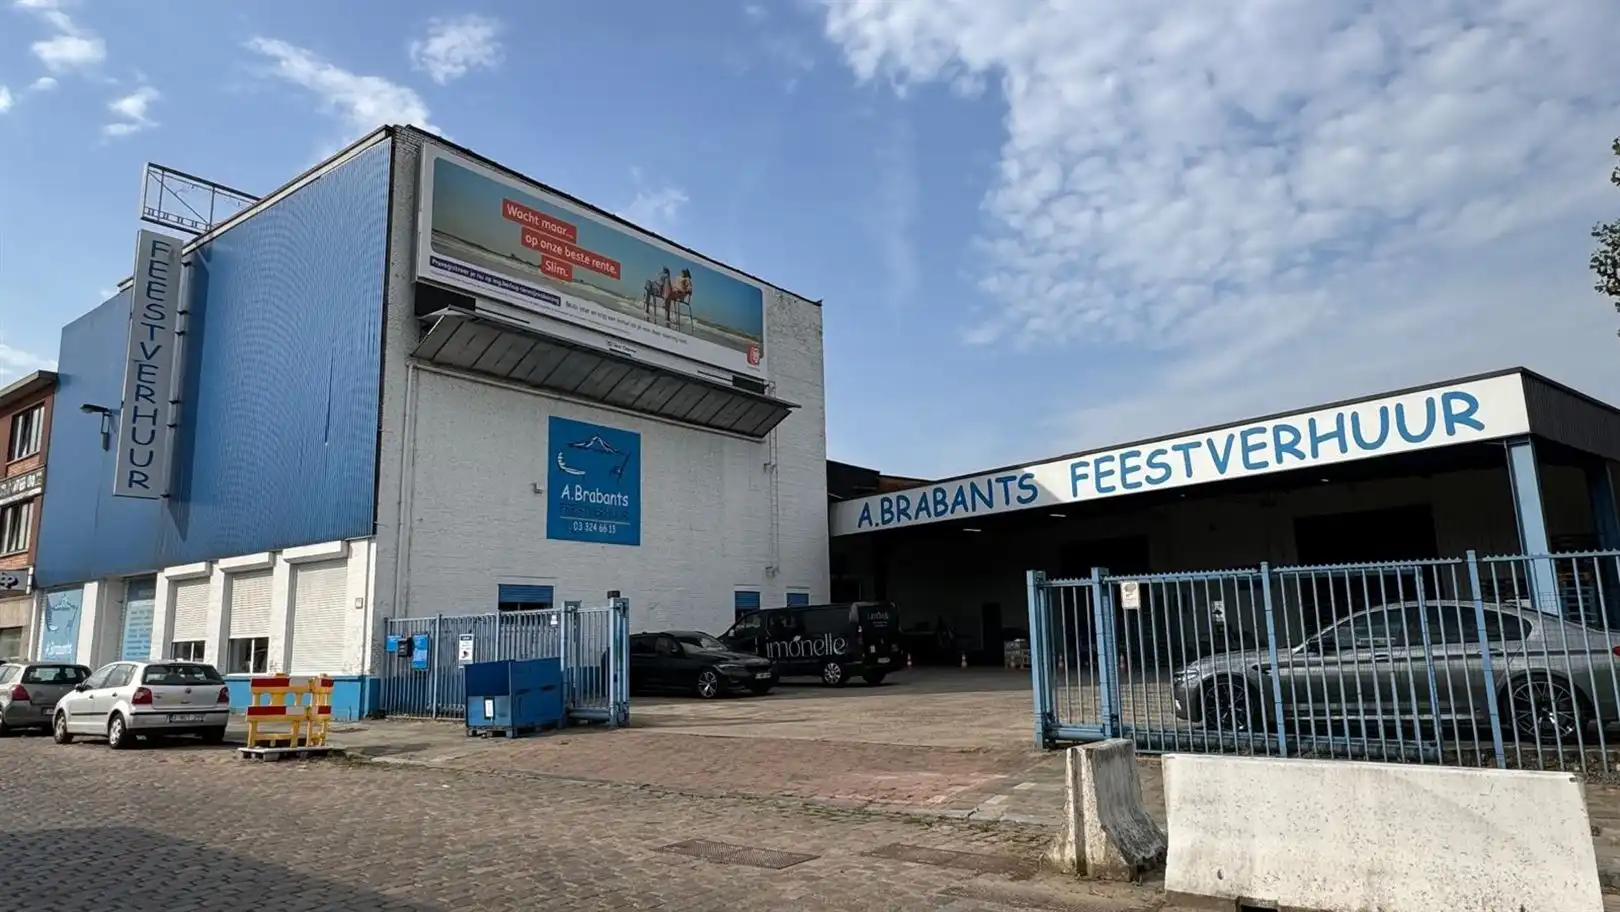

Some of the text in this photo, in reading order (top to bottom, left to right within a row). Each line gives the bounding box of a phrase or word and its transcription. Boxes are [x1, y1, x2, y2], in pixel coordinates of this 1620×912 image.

[507, 203, 539, 225] Wacht
[525, 234, 617, 274] op onze beste rente.
[545, 260, 569, 277] Slim.
[128, 239, 171, 489] FEESTVERHUUR
[857, 390, 1486, 529] A.BRABANTS FEESTVERHUUR
[561, 484, 629, 507] A.Brabants
[573, 520, 583, 531] 03
[584, 522, 597, 532] 324
